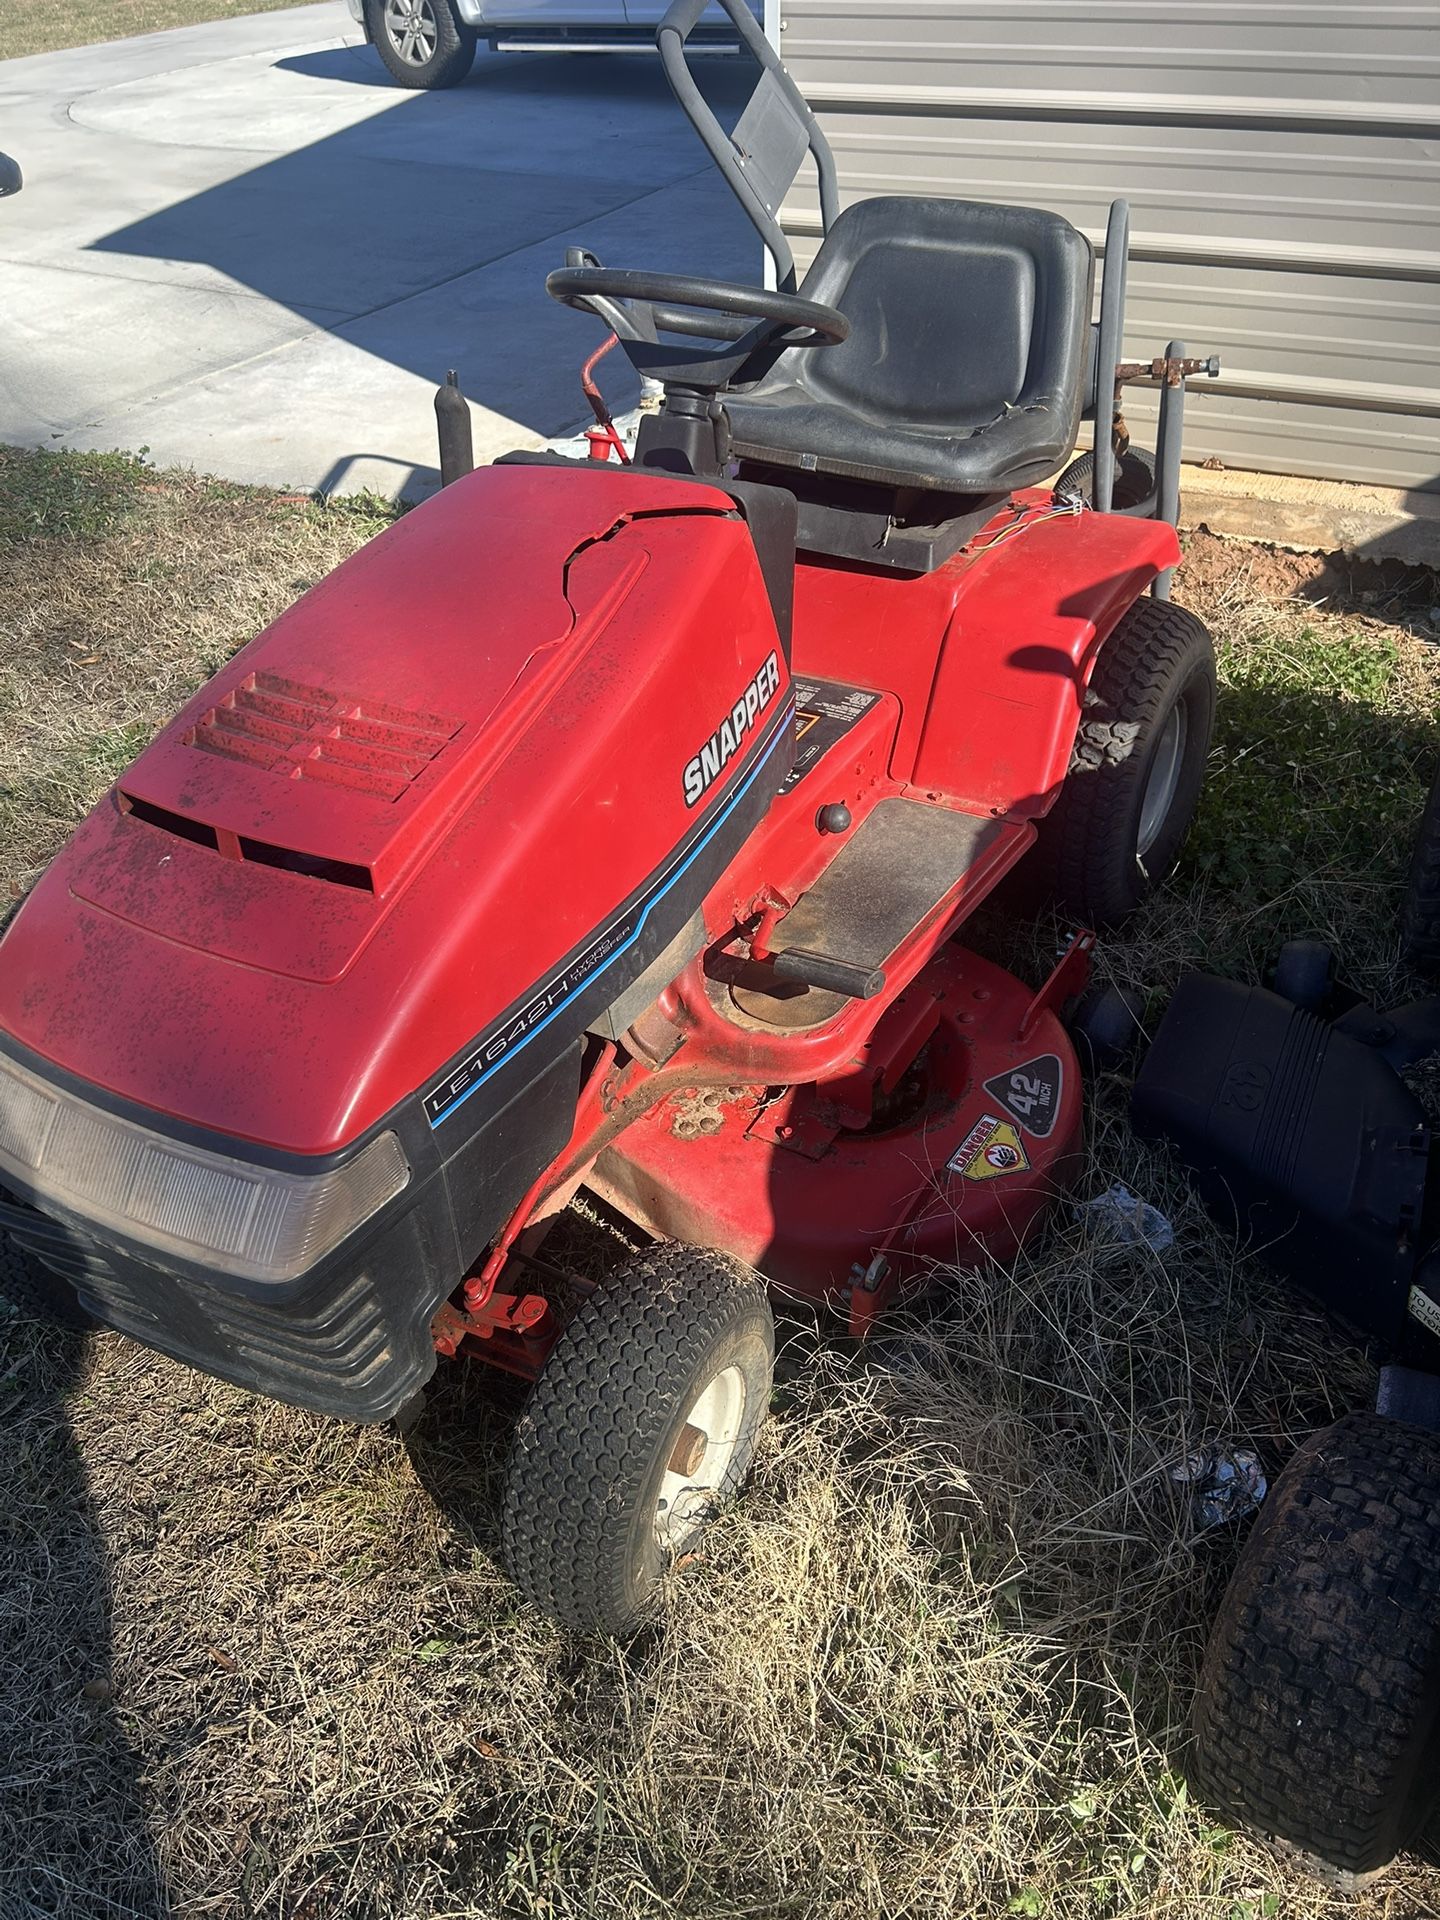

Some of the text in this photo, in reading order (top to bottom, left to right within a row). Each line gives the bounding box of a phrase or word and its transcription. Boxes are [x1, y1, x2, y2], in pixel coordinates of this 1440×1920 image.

[683, 650, 780, 807] SNAPPER
[570, 939, 611, 978] HYDRO
[573, 926, 631, 981] TRANSFER
[432, 979, 569, 1111] LE1642H
[1007, 1073, 1042, 1116] 42
[1038, 1082, 1052, 1107] INCH
[954, 1120, 995, 1168] DANGER
[1412, 1292, 1440, 1323] TO US
